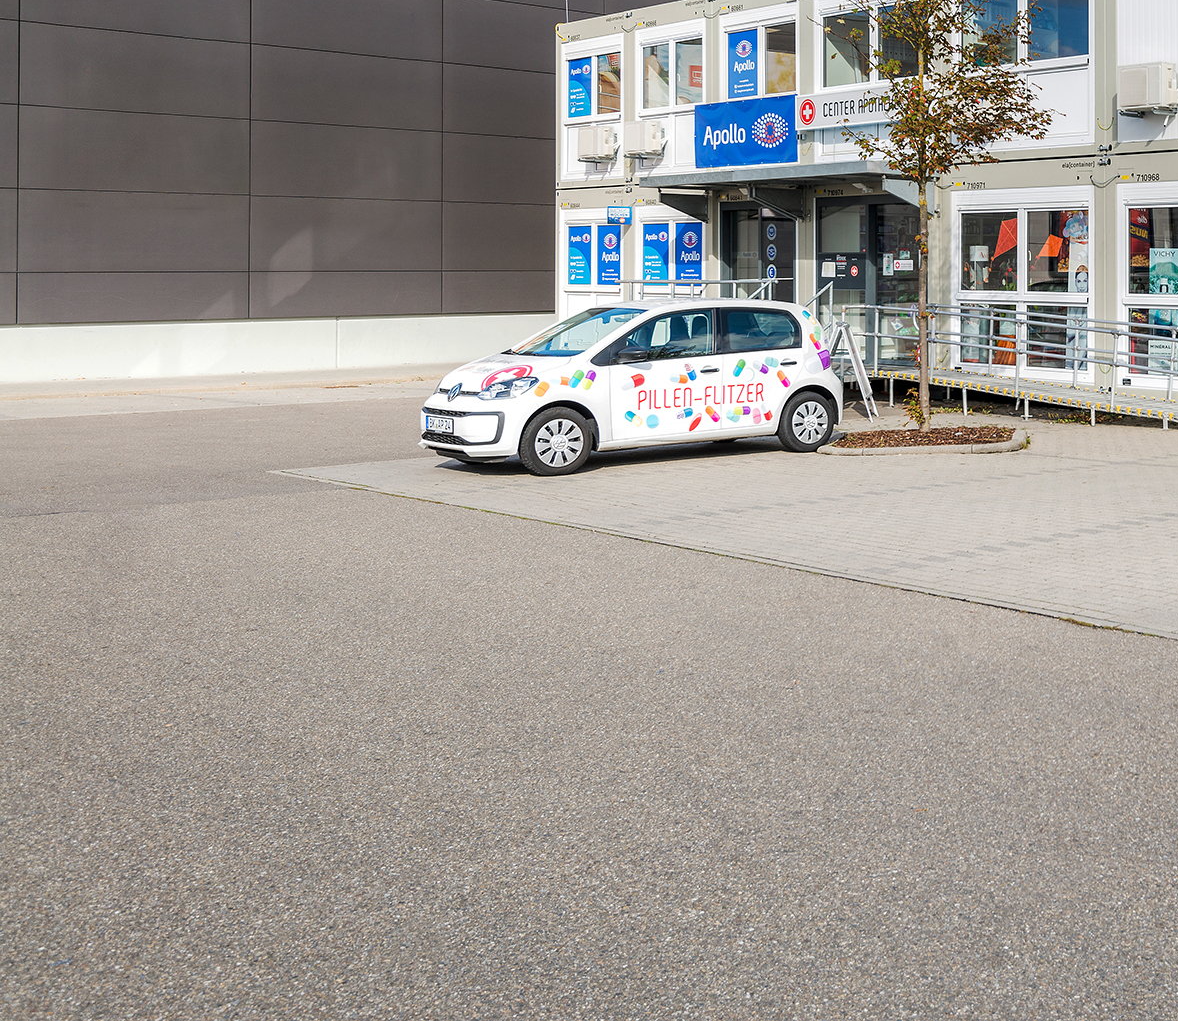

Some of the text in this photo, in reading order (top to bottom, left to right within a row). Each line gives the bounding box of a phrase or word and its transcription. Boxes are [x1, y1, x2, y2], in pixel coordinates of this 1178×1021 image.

[733, 59, 756, 74] Apollo
[822, 99, 856, 118] CENTER
[702, 123, 746, 150] Apollo
[1061, 160, 1095, 169] ela[container]
[1136, 173, 1160, 182] 710968
[966, 182, 986, 190] 710971
[645, 233, 658, 242] Apollo
[601, 251, 620, 263] Apollo
[680, 250, 701, 263] Apollo
[637, 382, 765, 411] PILLEN-FLITZER
